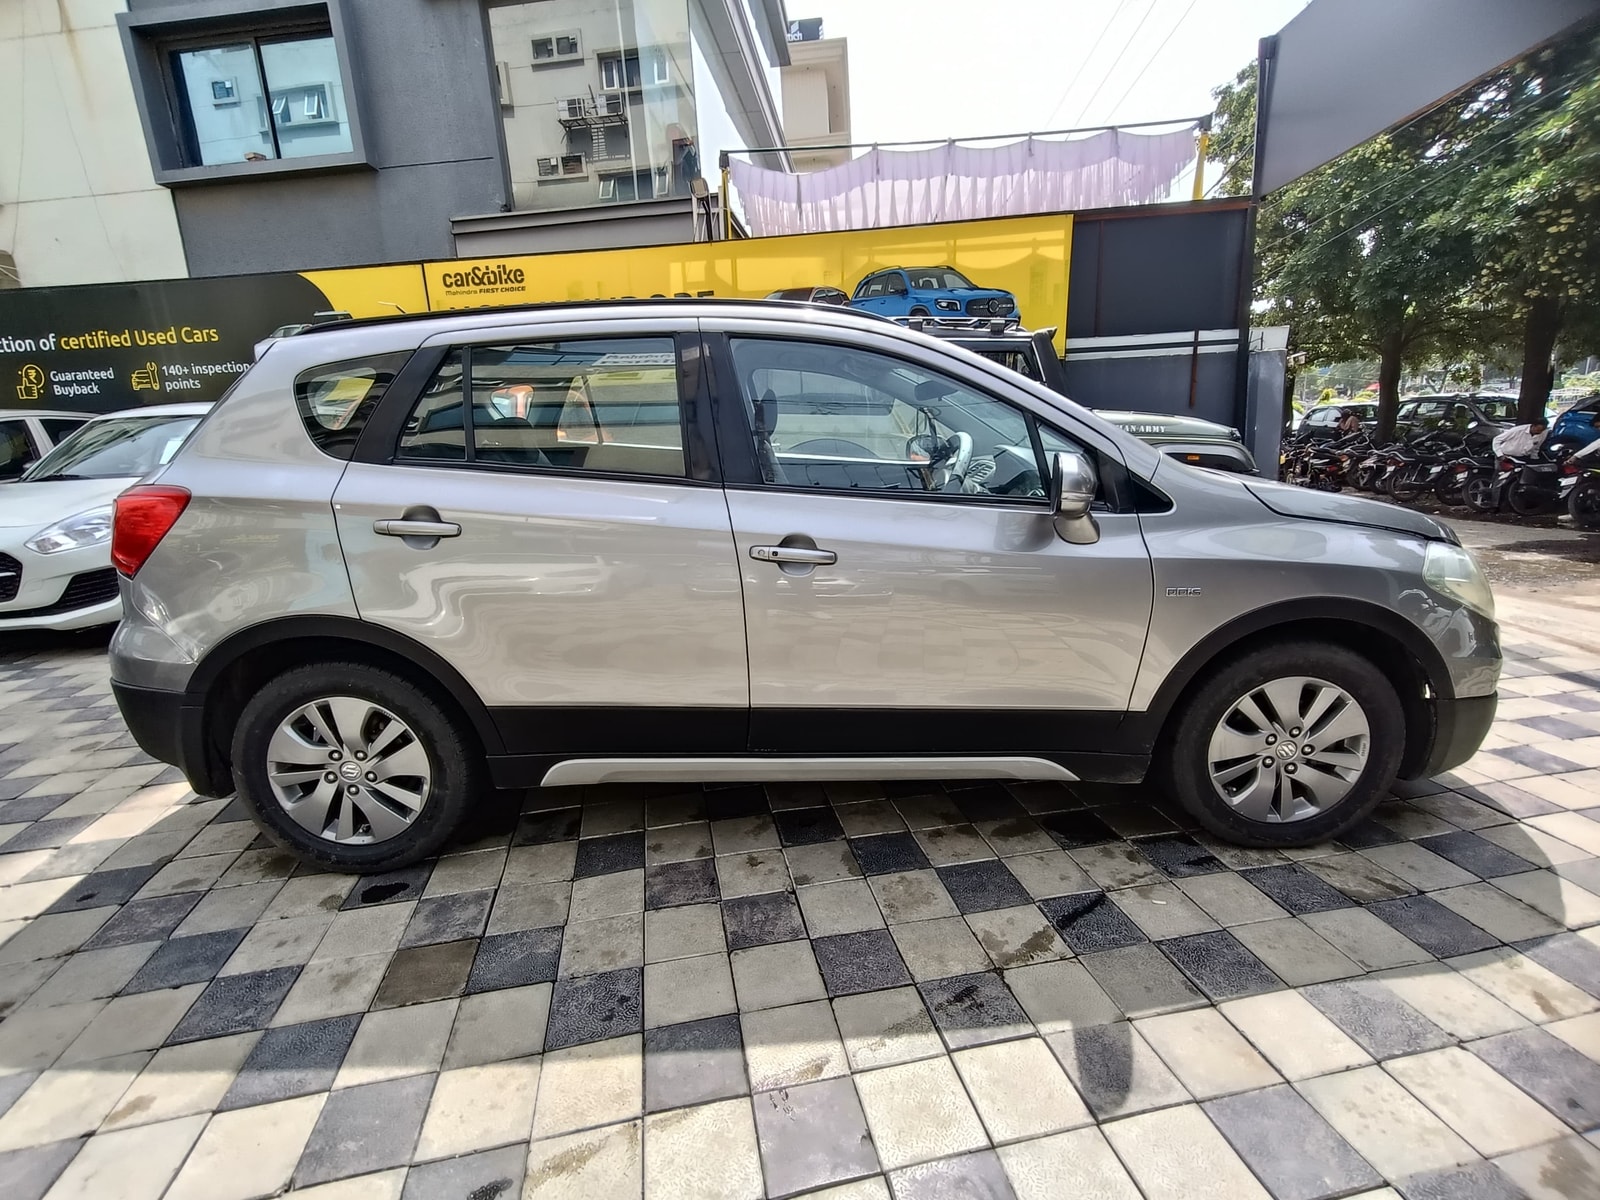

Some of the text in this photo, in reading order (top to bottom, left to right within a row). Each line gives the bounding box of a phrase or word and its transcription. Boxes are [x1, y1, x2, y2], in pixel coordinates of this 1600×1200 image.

[442, 265, 525, 288] car&bike
[39, 333, 57, 351] of
[60, 329, 132, 350] certified
[134, 326, 178, 346] Used
[181, 326, 219, 343] Cars
[49, 367, 114, 382] Guaranteed
[161, 361, 250, 376] 140+ inspection
[53, 382, 100, 397] Buyback
[165, 378, 201, 392] points
[1139, 425, 1166, 433] ARMY
